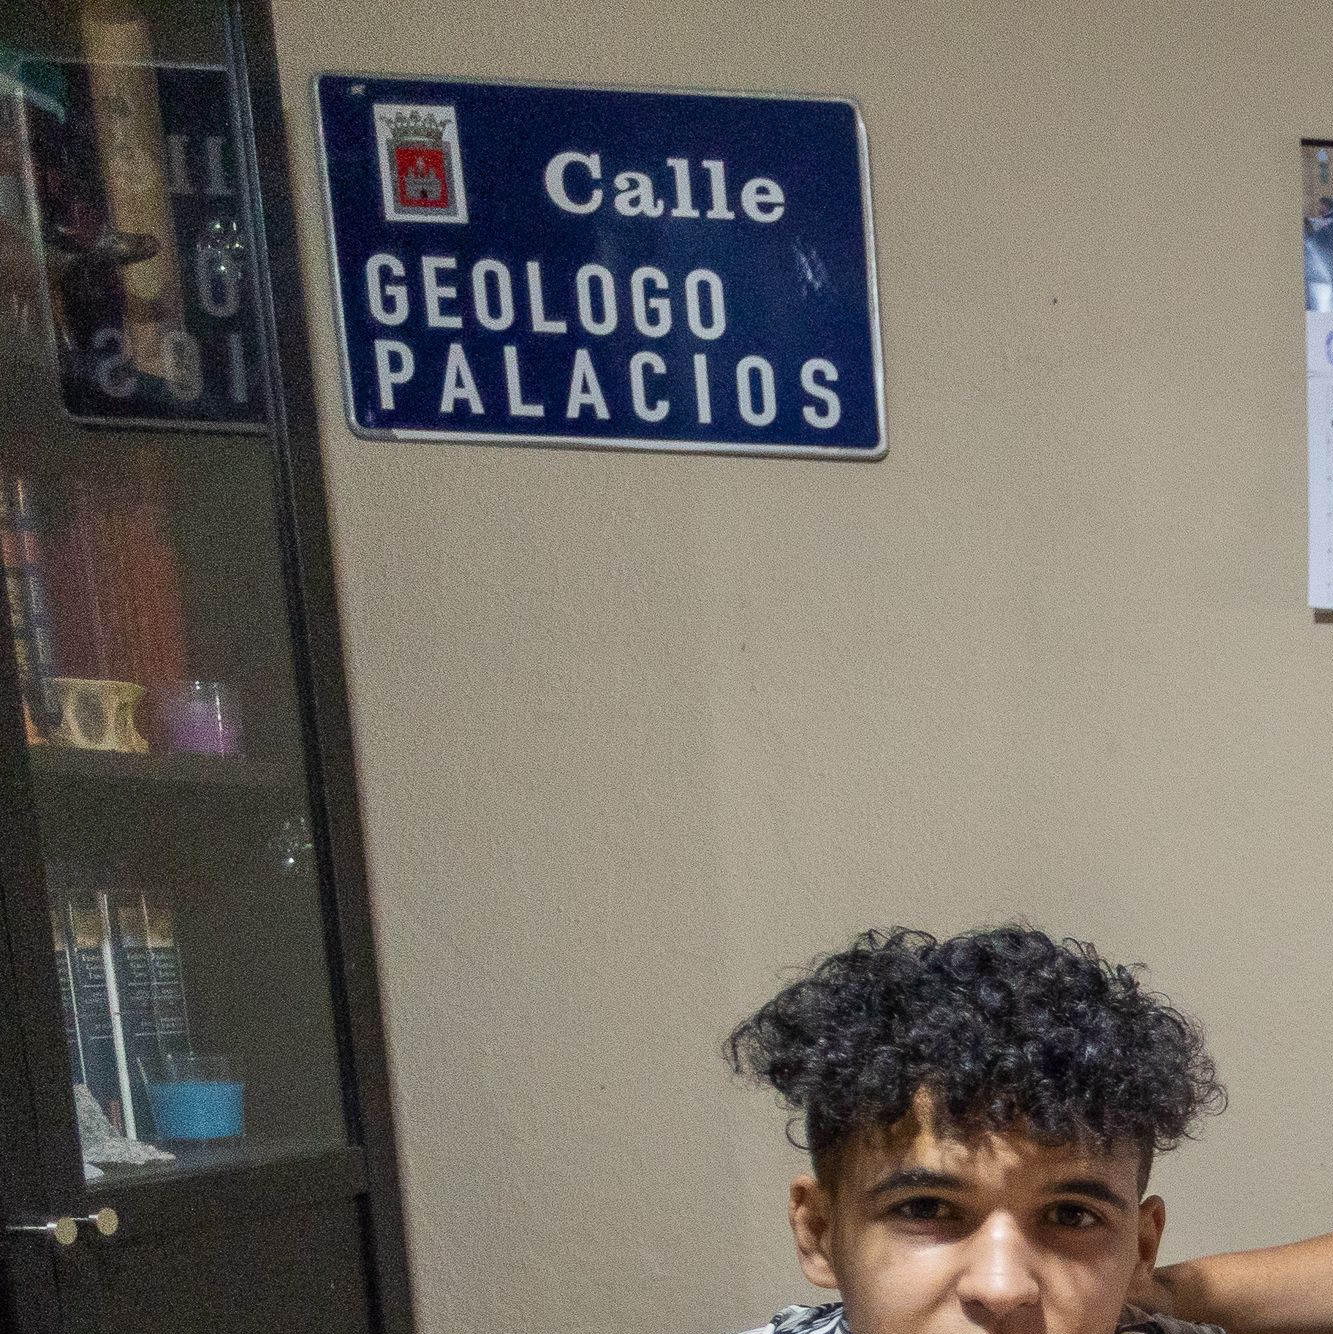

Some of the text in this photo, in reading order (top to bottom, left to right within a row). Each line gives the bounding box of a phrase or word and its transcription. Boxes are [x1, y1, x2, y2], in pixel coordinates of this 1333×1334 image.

[545, 152, 785, 223] Calle
[366, 253, 727, 340] GEOLOGO
[374, 338, 842, 429] PALACIOS
